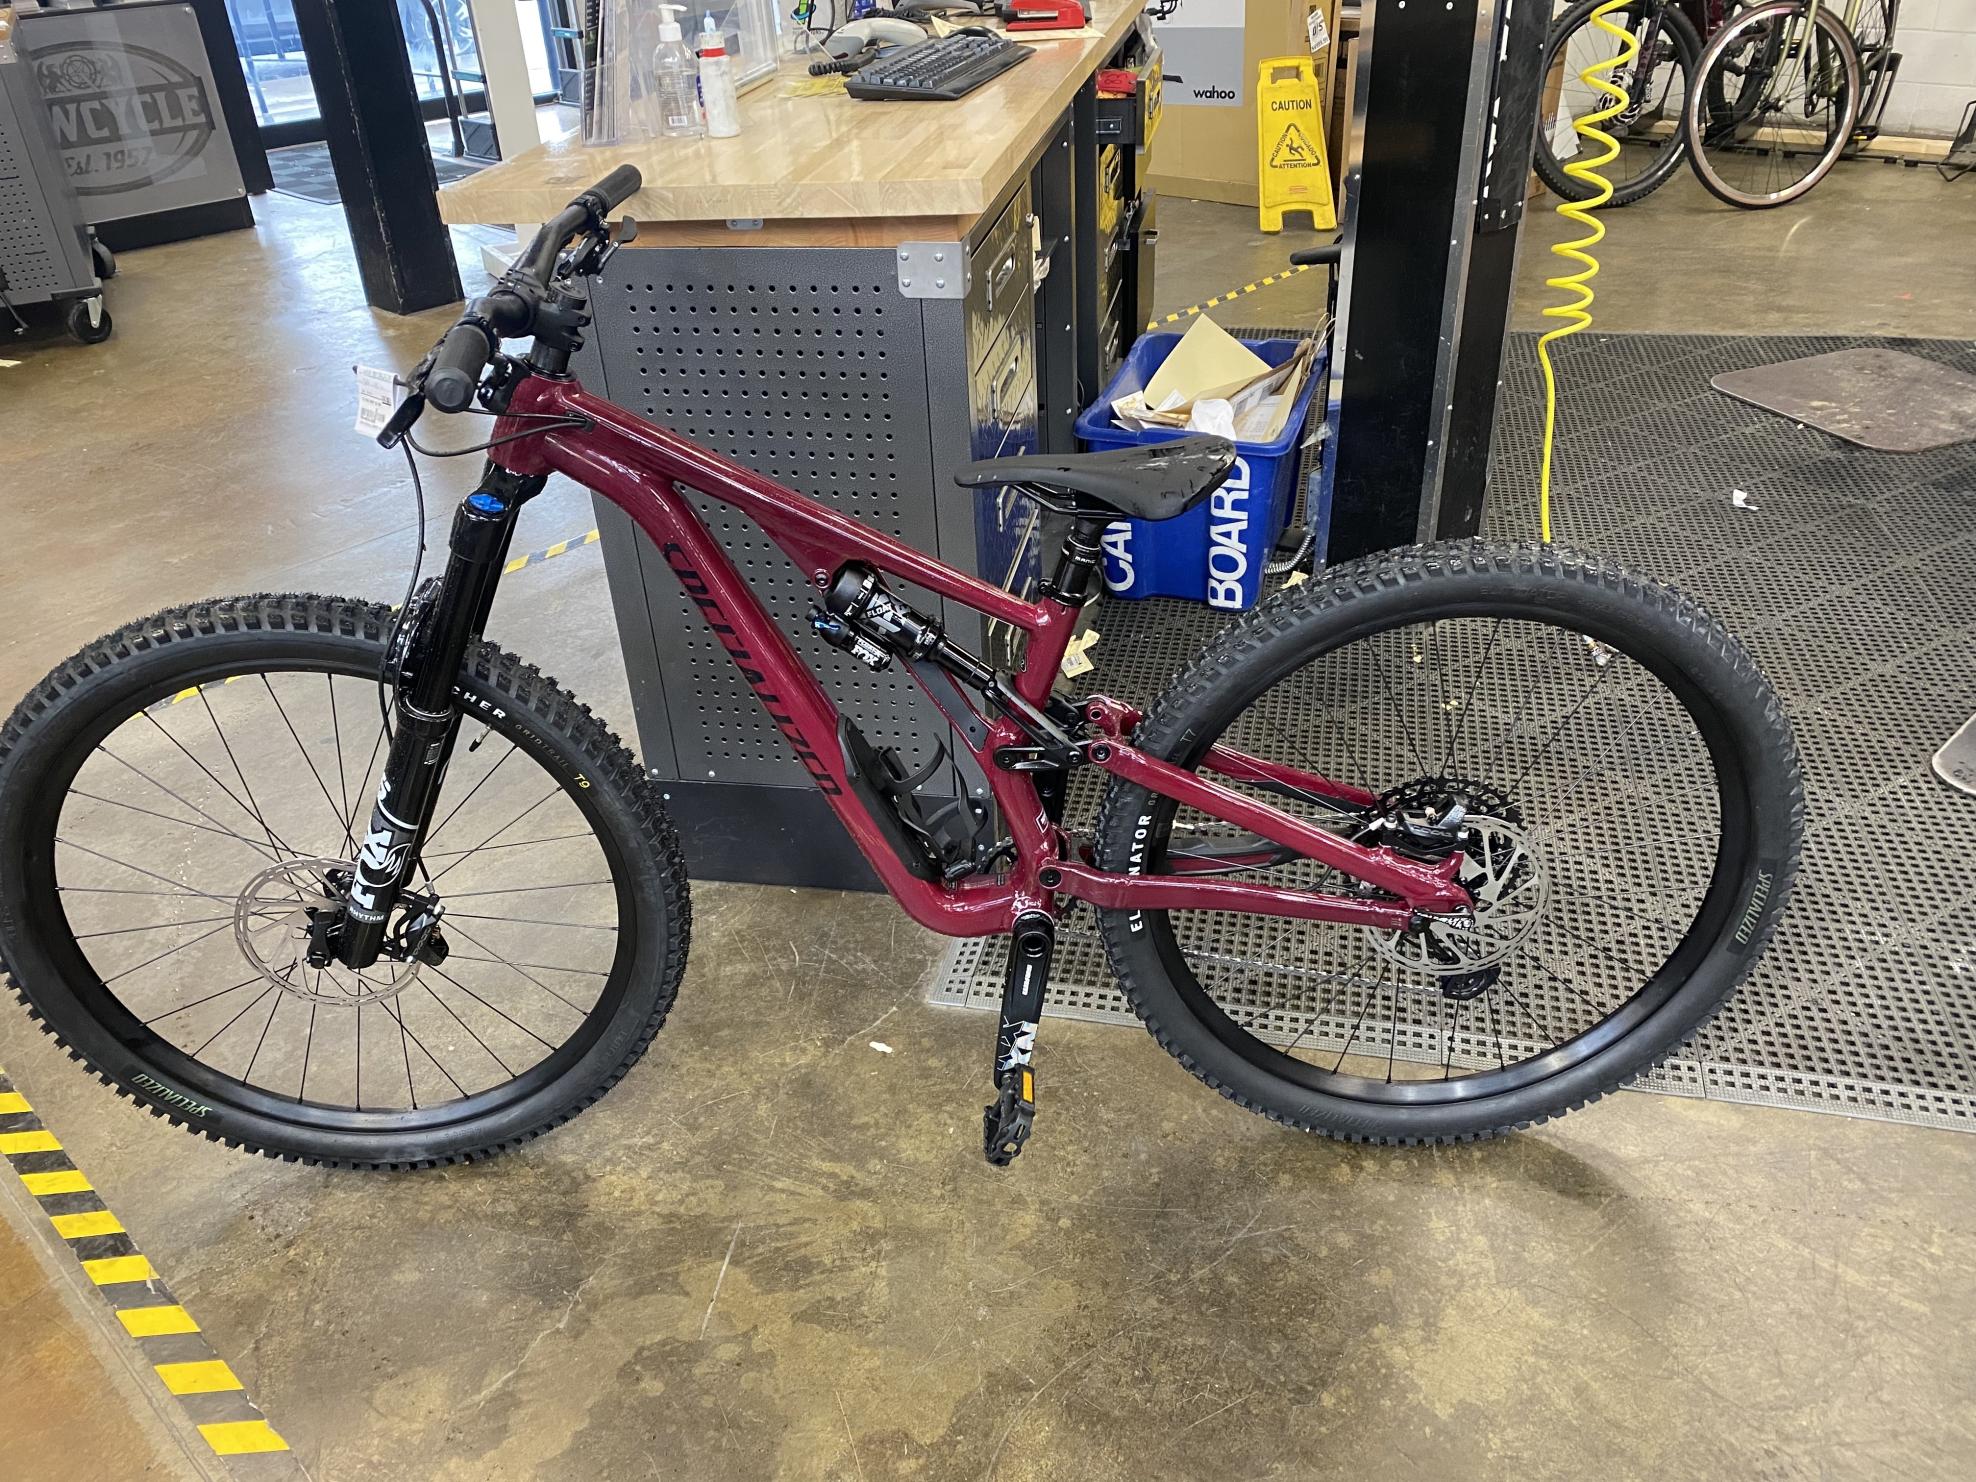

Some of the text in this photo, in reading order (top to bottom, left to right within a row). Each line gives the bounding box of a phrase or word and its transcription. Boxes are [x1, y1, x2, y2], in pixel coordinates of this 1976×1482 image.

[1193, 85, 1236, 100] wahoo
[1271, 99, 1312, 111] CAUTION
[1272, 133, 1288, 158] CAUTION
[1100, 521, 1135, 592] CA
[851, 644, 879, 666] FOX
[452, 686, 506, 719] CHER
[1128, 814, 1152, 933] ELNATOR
[1735, 869, 1774, 945] SPECIALIZED
[131, 1073, 213, 1118] SPECIALIZED
